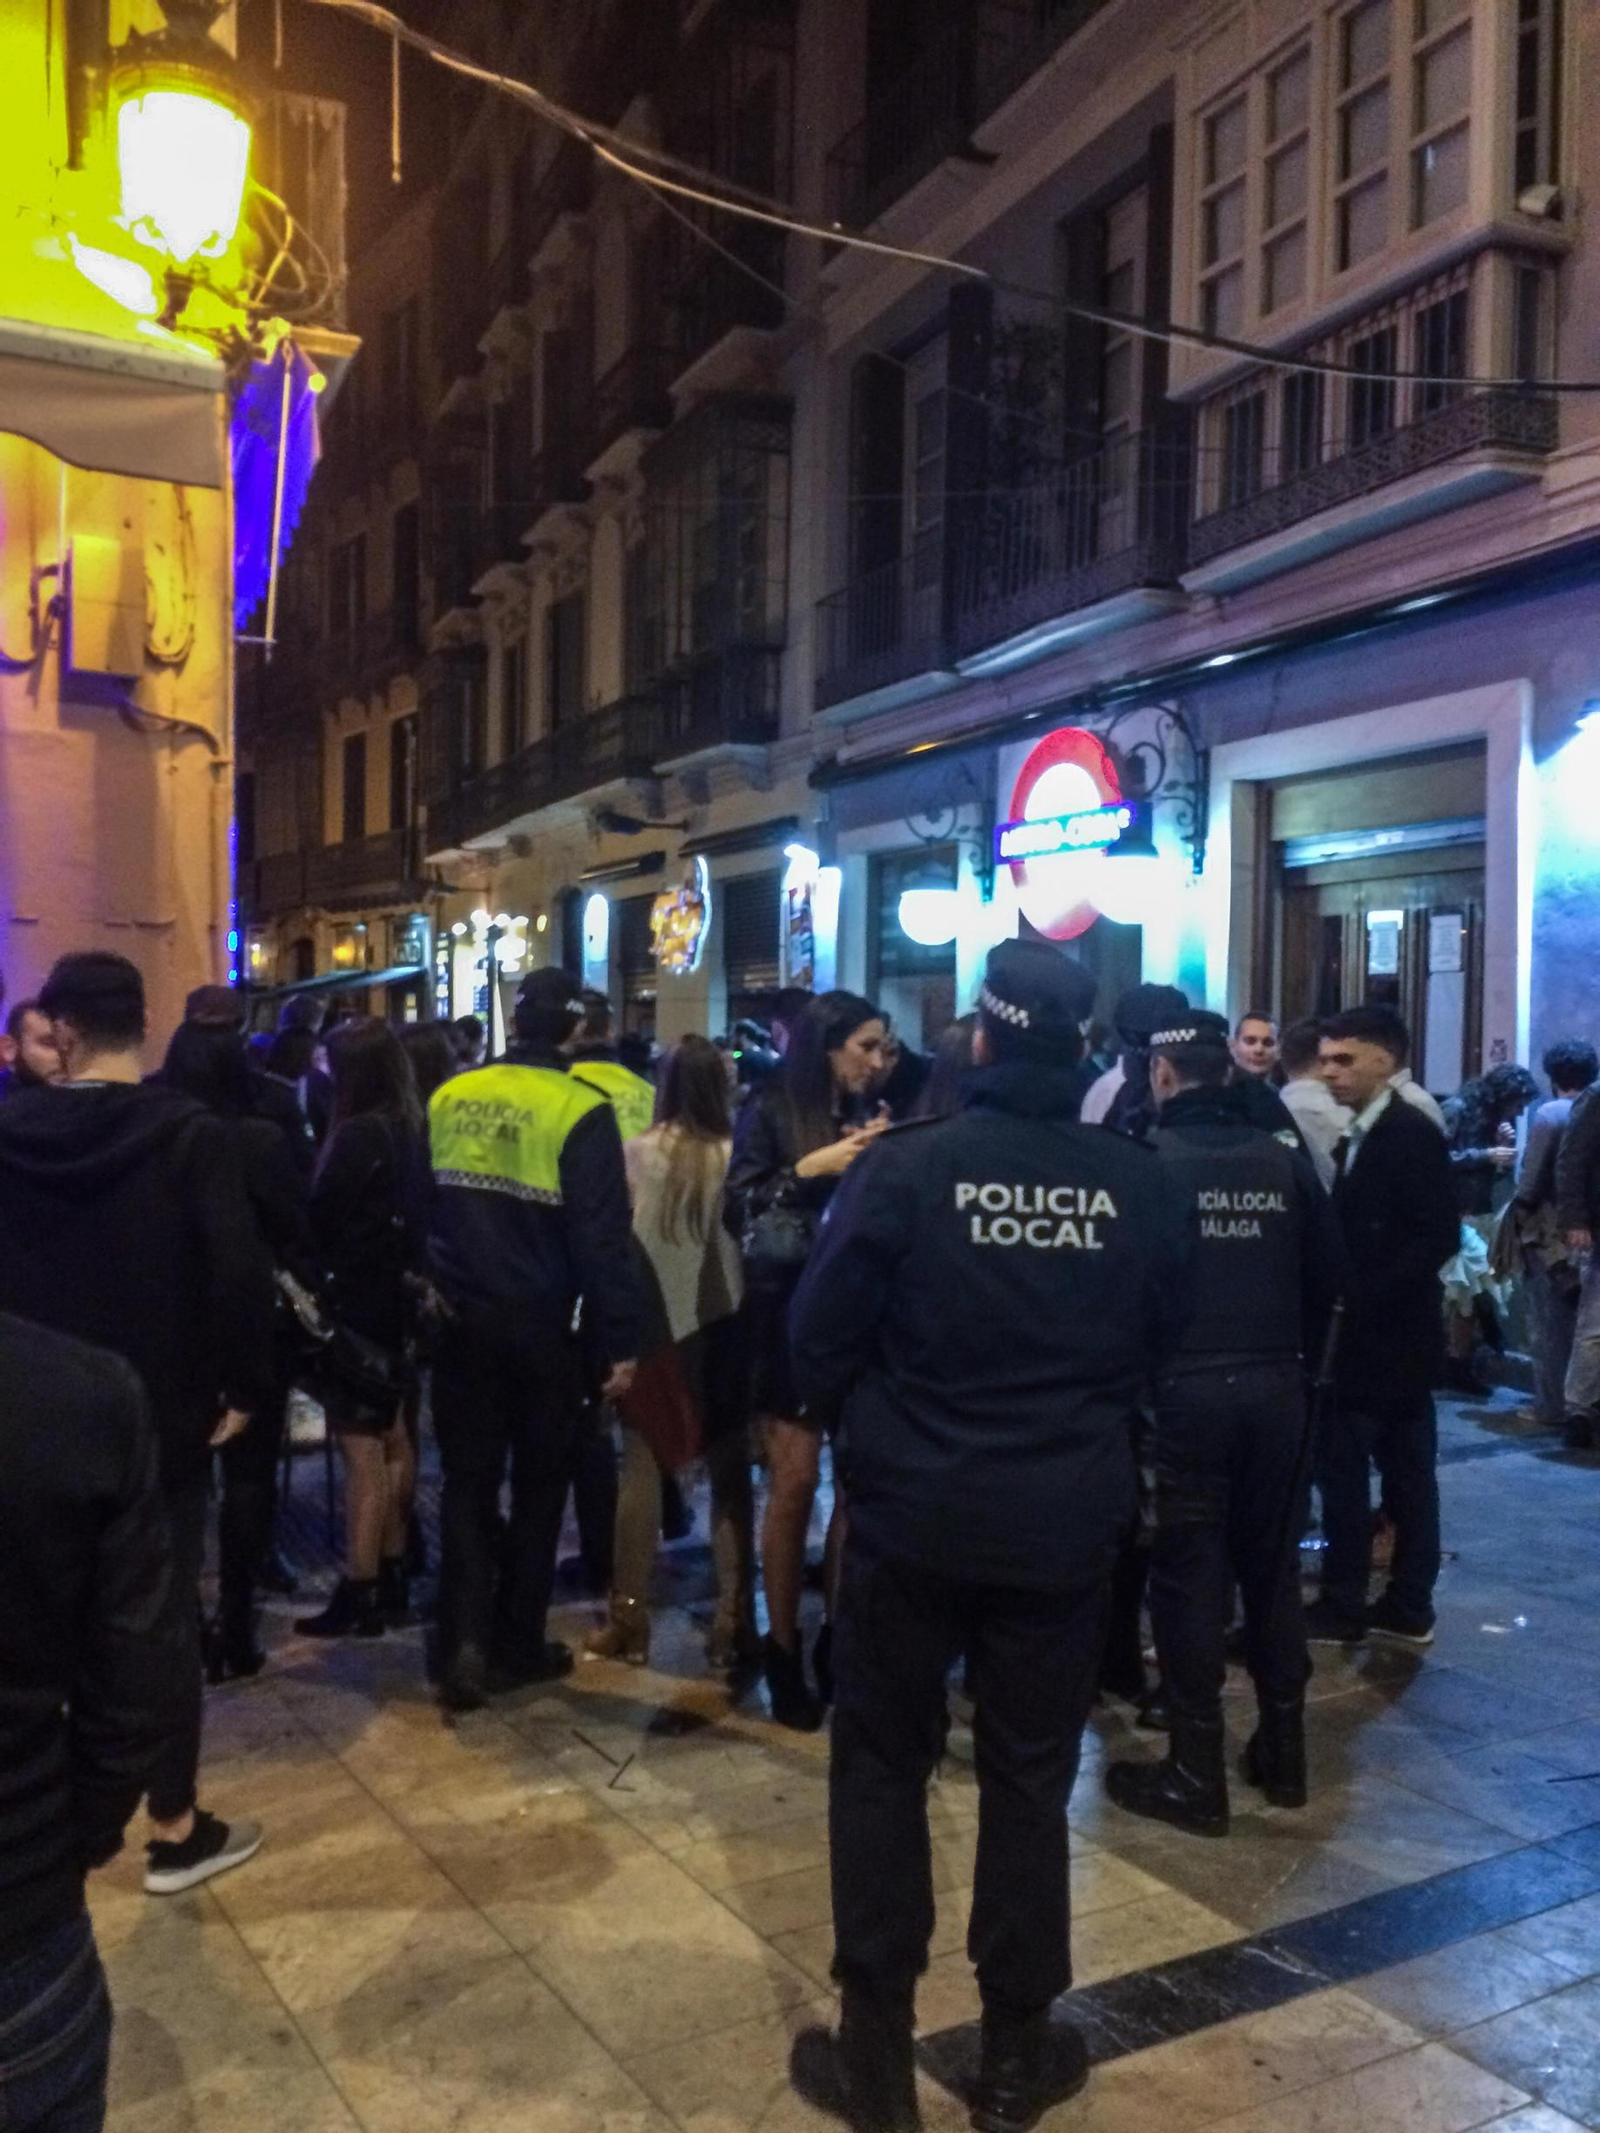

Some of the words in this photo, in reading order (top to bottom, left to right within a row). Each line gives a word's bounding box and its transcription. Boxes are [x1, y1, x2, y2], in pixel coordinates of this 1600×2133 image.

[955, 1182, 1118, 1218] POLICIA
[1233, 1192, 1287, 1212] LOCAL
[970, 1214, 1104, 1250] LOCAL
